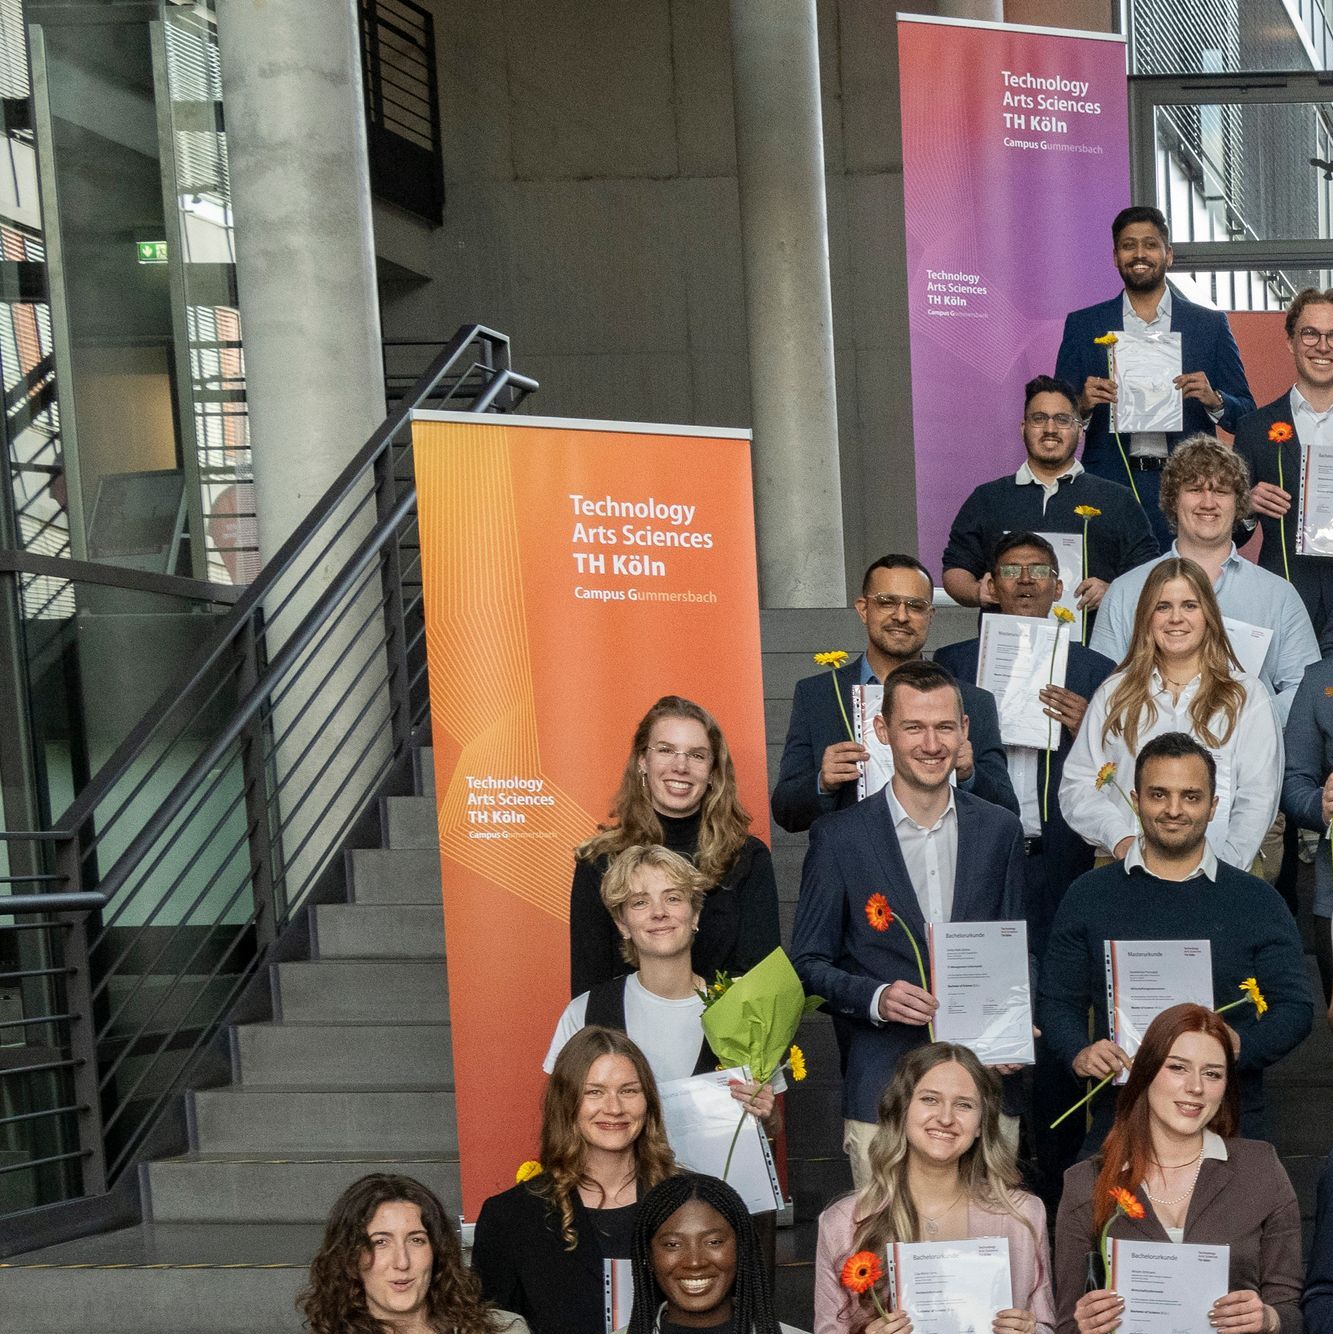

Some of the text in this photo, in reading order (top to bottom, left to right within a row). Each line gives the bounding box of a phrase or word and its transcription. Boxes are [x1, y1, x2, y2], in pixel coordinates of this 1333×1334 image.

[1001, 71, 1089, 96] Technology
[1003, 91, 1101, 114] Arts Sciences
[1003, 113, 1067, 133] TH Köln
[1004, 137, 1103, 154] Campus Gummersbach
[926, 270, 980, 284] Technology
[927, 281, 987, 295] Arts Sciences
[928, 295, 966, 306] TH Köln
[928, 309, 949, 317] Campus
[570, 494, 696, 525] Technology
[573, 522, 714, 549] Arts Sciences
[574, 552, 667, 578] TH Köln
[575, 585, 719, 605] Campus Gummersbach
[467, 776, 544, 792] Technology
[468, 792, 556, 806] Arts Sciences
[470, 810, 526, 824] TH Köln
[470, 831, 502, 839] Campus
[1131, 1252, 1178, 1262] Bachelorurkunde
